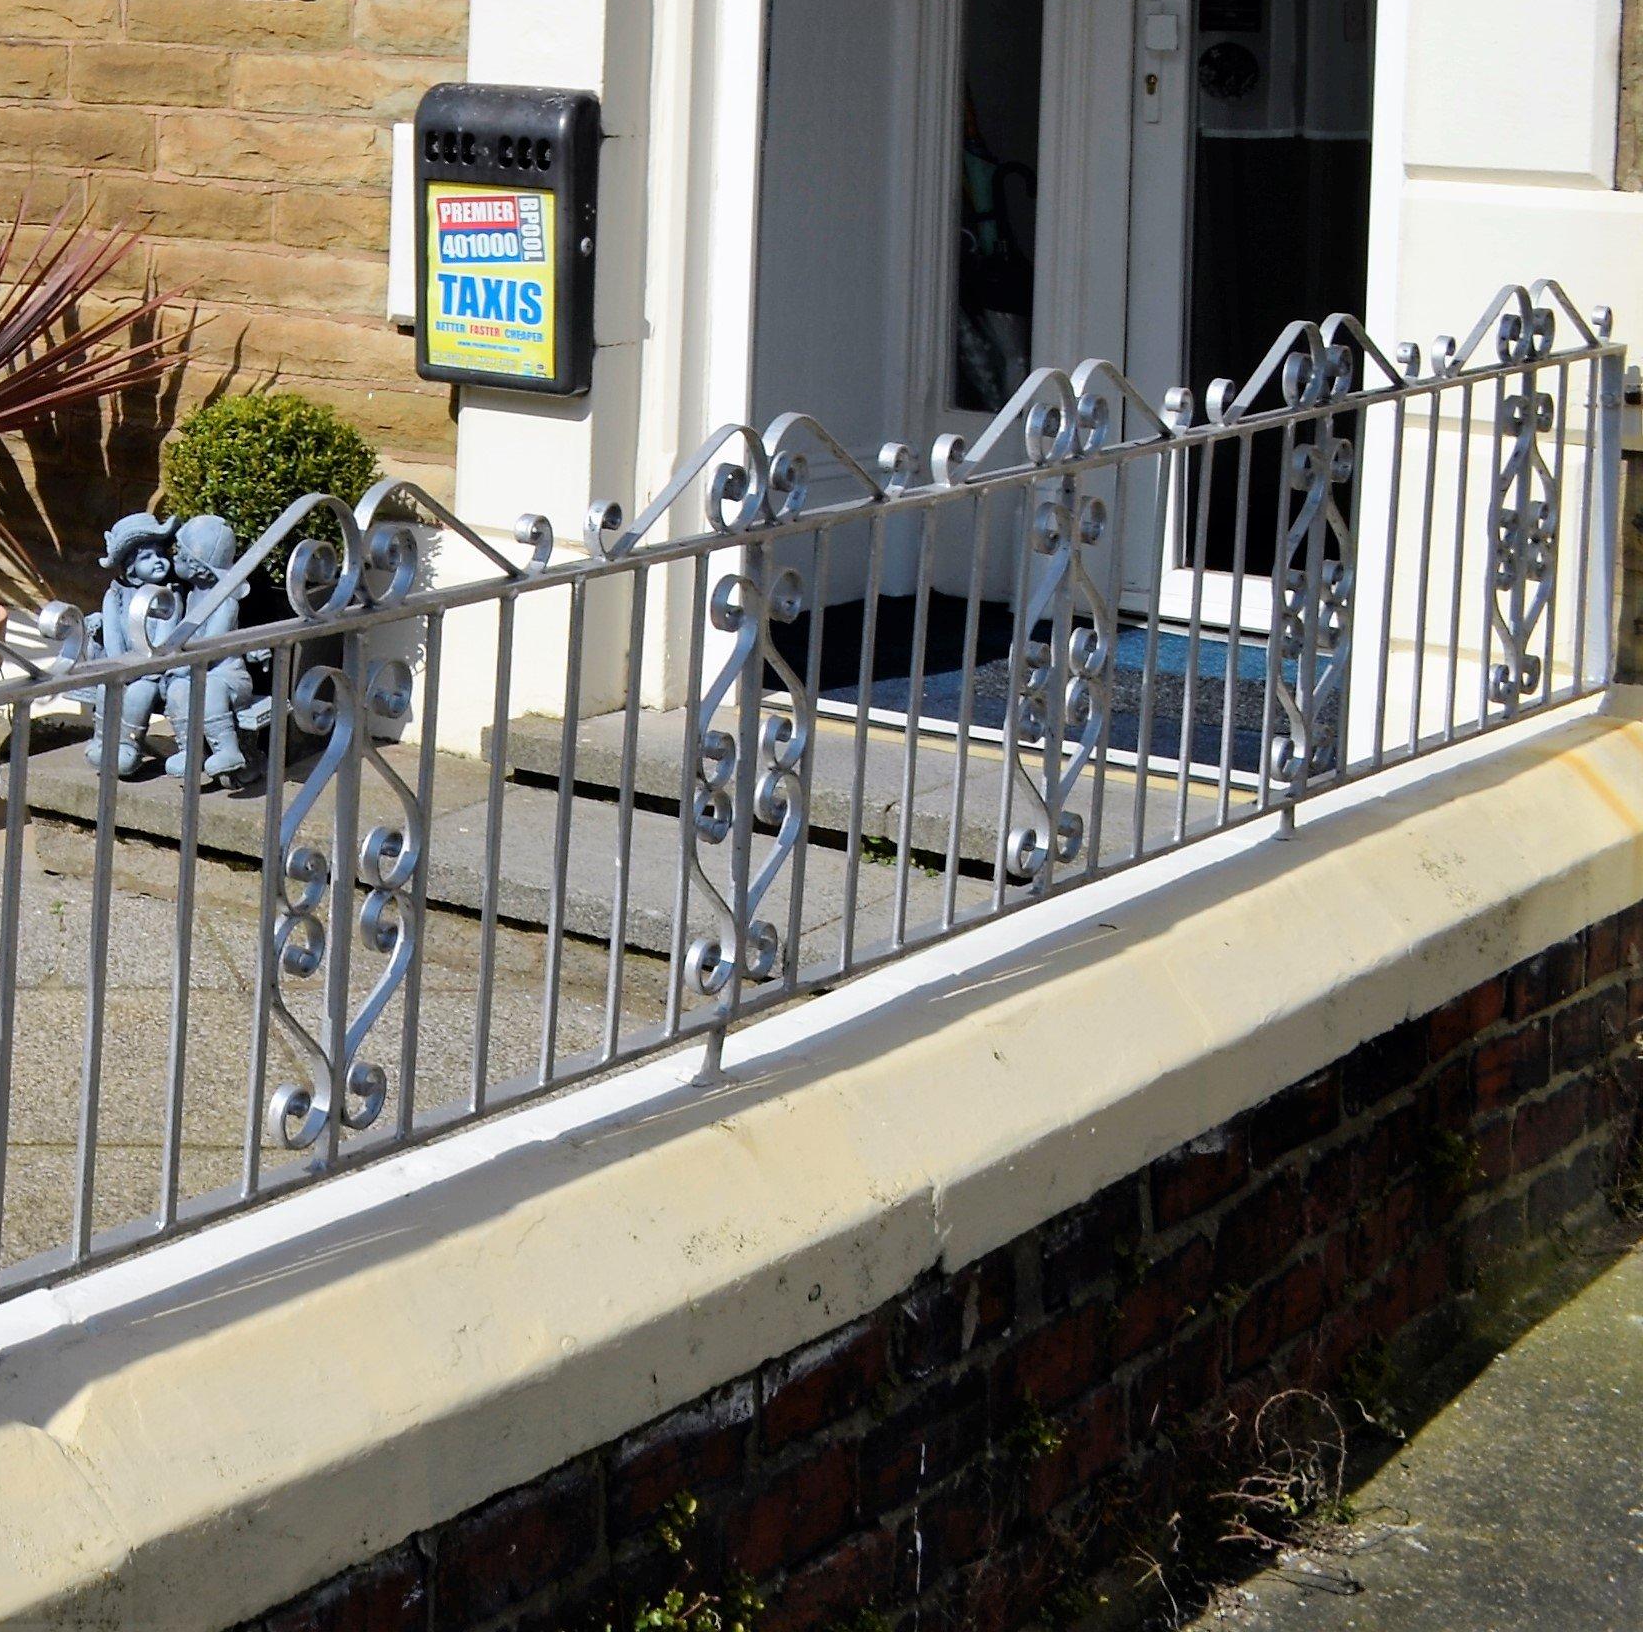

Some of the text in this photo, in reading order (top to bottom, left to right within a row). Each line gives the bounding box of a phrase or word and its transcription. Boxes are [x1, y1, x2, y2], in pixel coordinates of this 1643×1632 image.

[438, 201, 515, 224] PREMIER
[518, 197, 544, 261] BPOOL
[442, 232, 519, 258] 401000
[438, 273, 543, 326] TAXIS
[435, 320, 543, 342] BETTER FASTER CHEAPER
